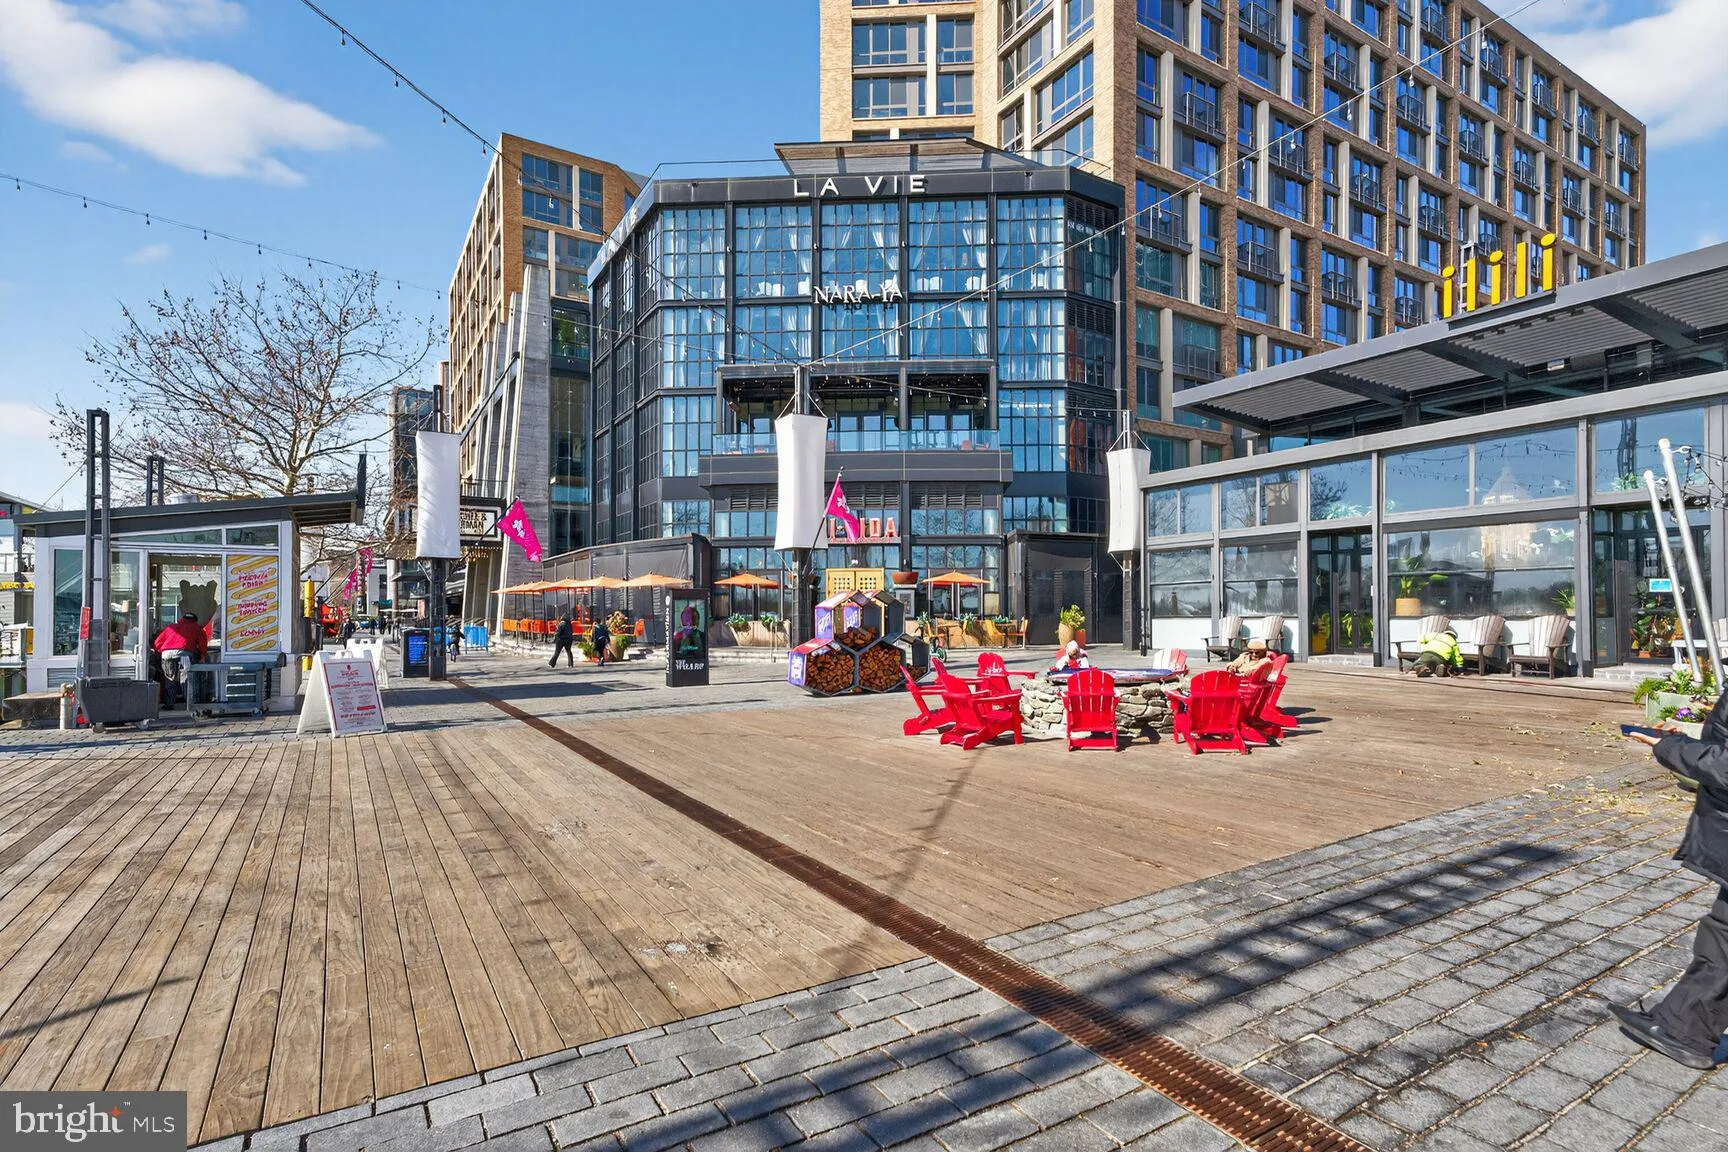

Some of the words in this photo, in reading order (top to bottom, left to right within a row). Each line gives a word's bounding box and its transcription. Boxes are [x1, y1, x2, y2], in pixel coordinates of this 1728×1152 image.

[793, 177, 840, 198] LA
[864, 174, 926, 195] VIE
[1441, 233, 1556, 319] ilili
[813, 284, 903, 304] NARA-YA
